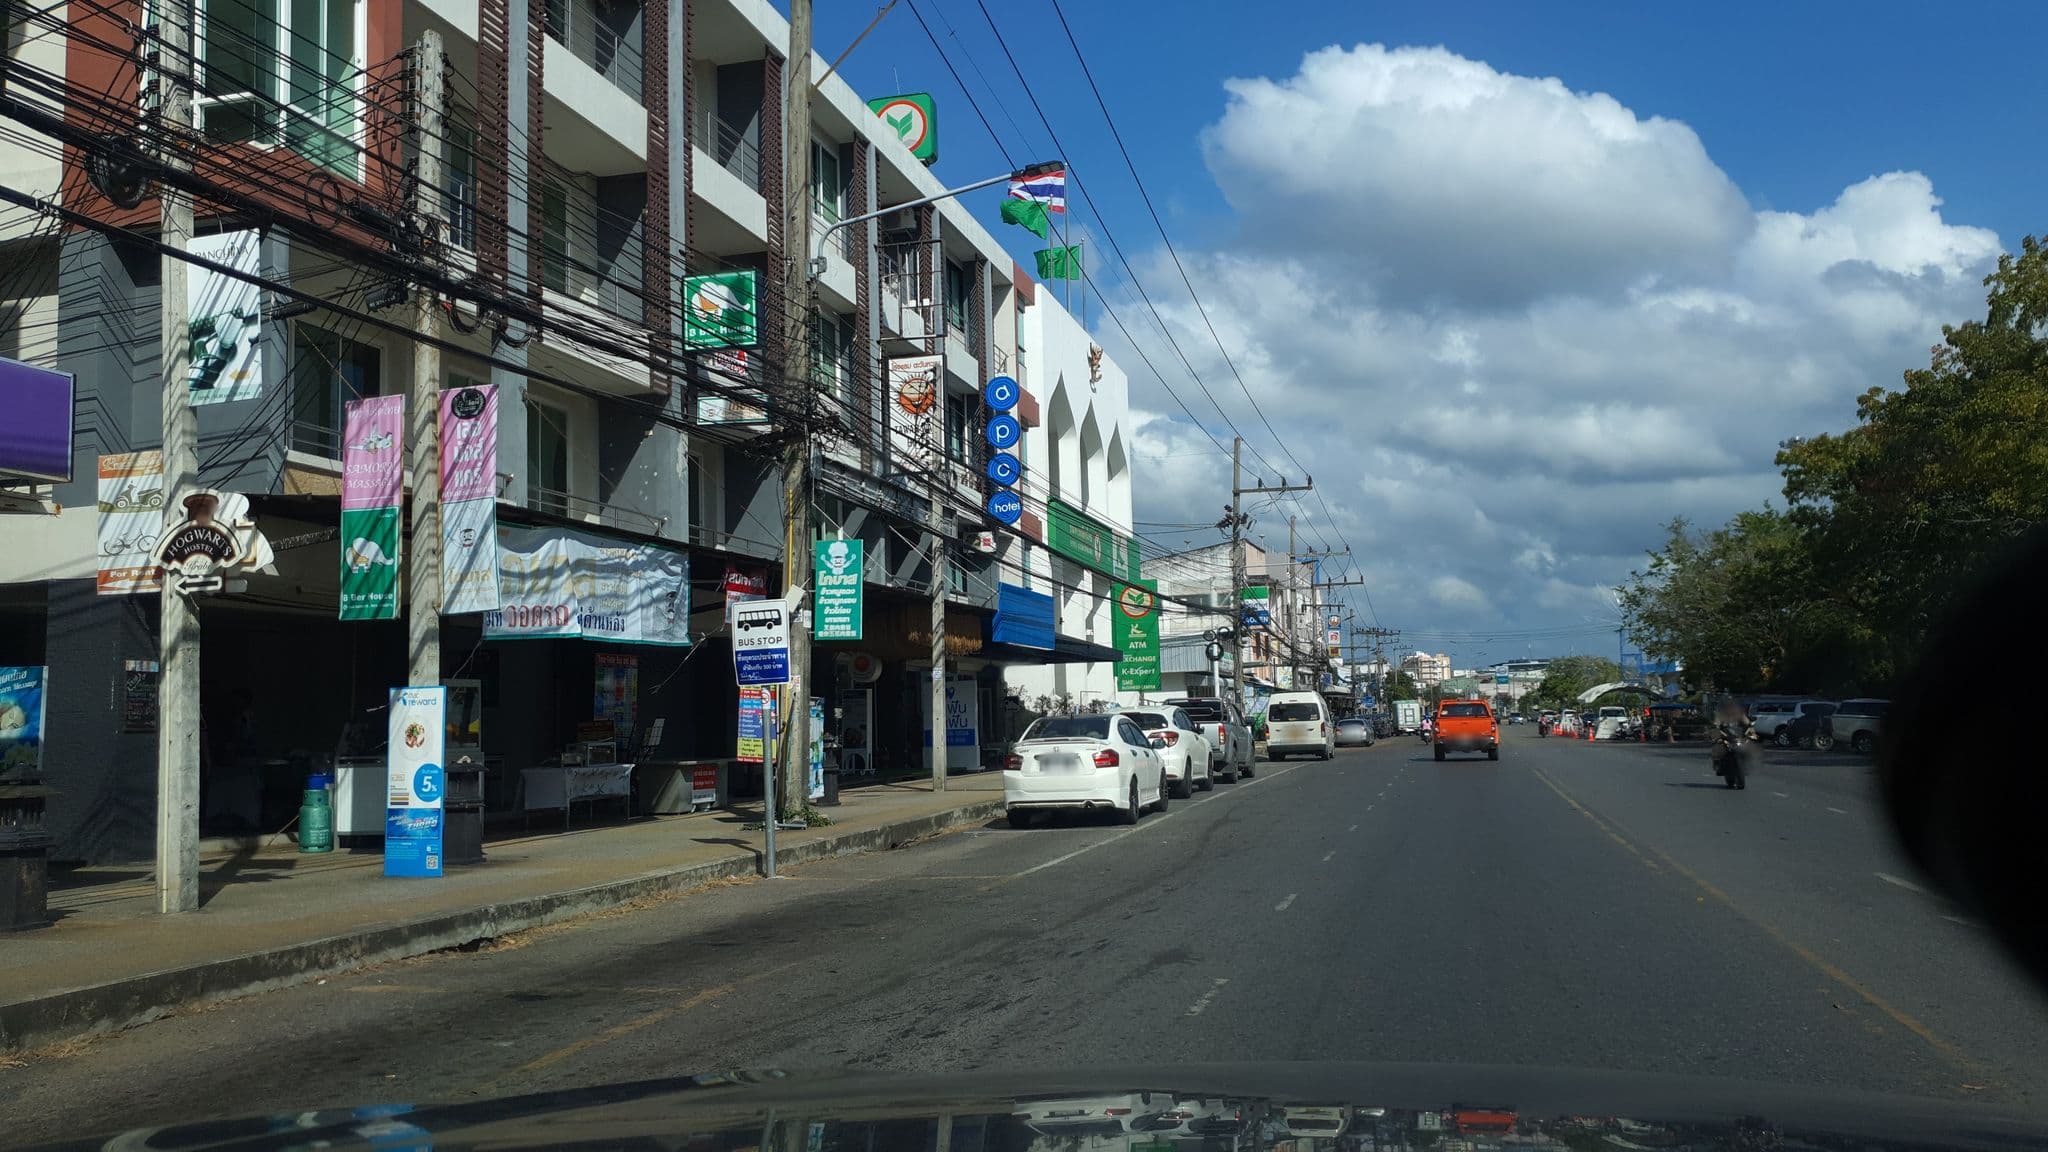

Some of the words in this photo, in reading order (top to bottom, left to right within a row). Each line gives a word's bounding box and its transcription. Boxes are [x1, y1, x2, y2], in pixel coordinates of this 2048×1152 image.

[994, 501, 1021, 513] hotel
[167, 529, 232, 557] HOGWARTS
[184, 543, 214, 555] HOSTEL
[738, 638, 755, 647] BUS
[757, 636, 783, 645] STOP
[1129, 641, 1147, 649] ATM
[1123, 655, 1156, 663] XCHANGE
[408, 696, 437, 706] reward
